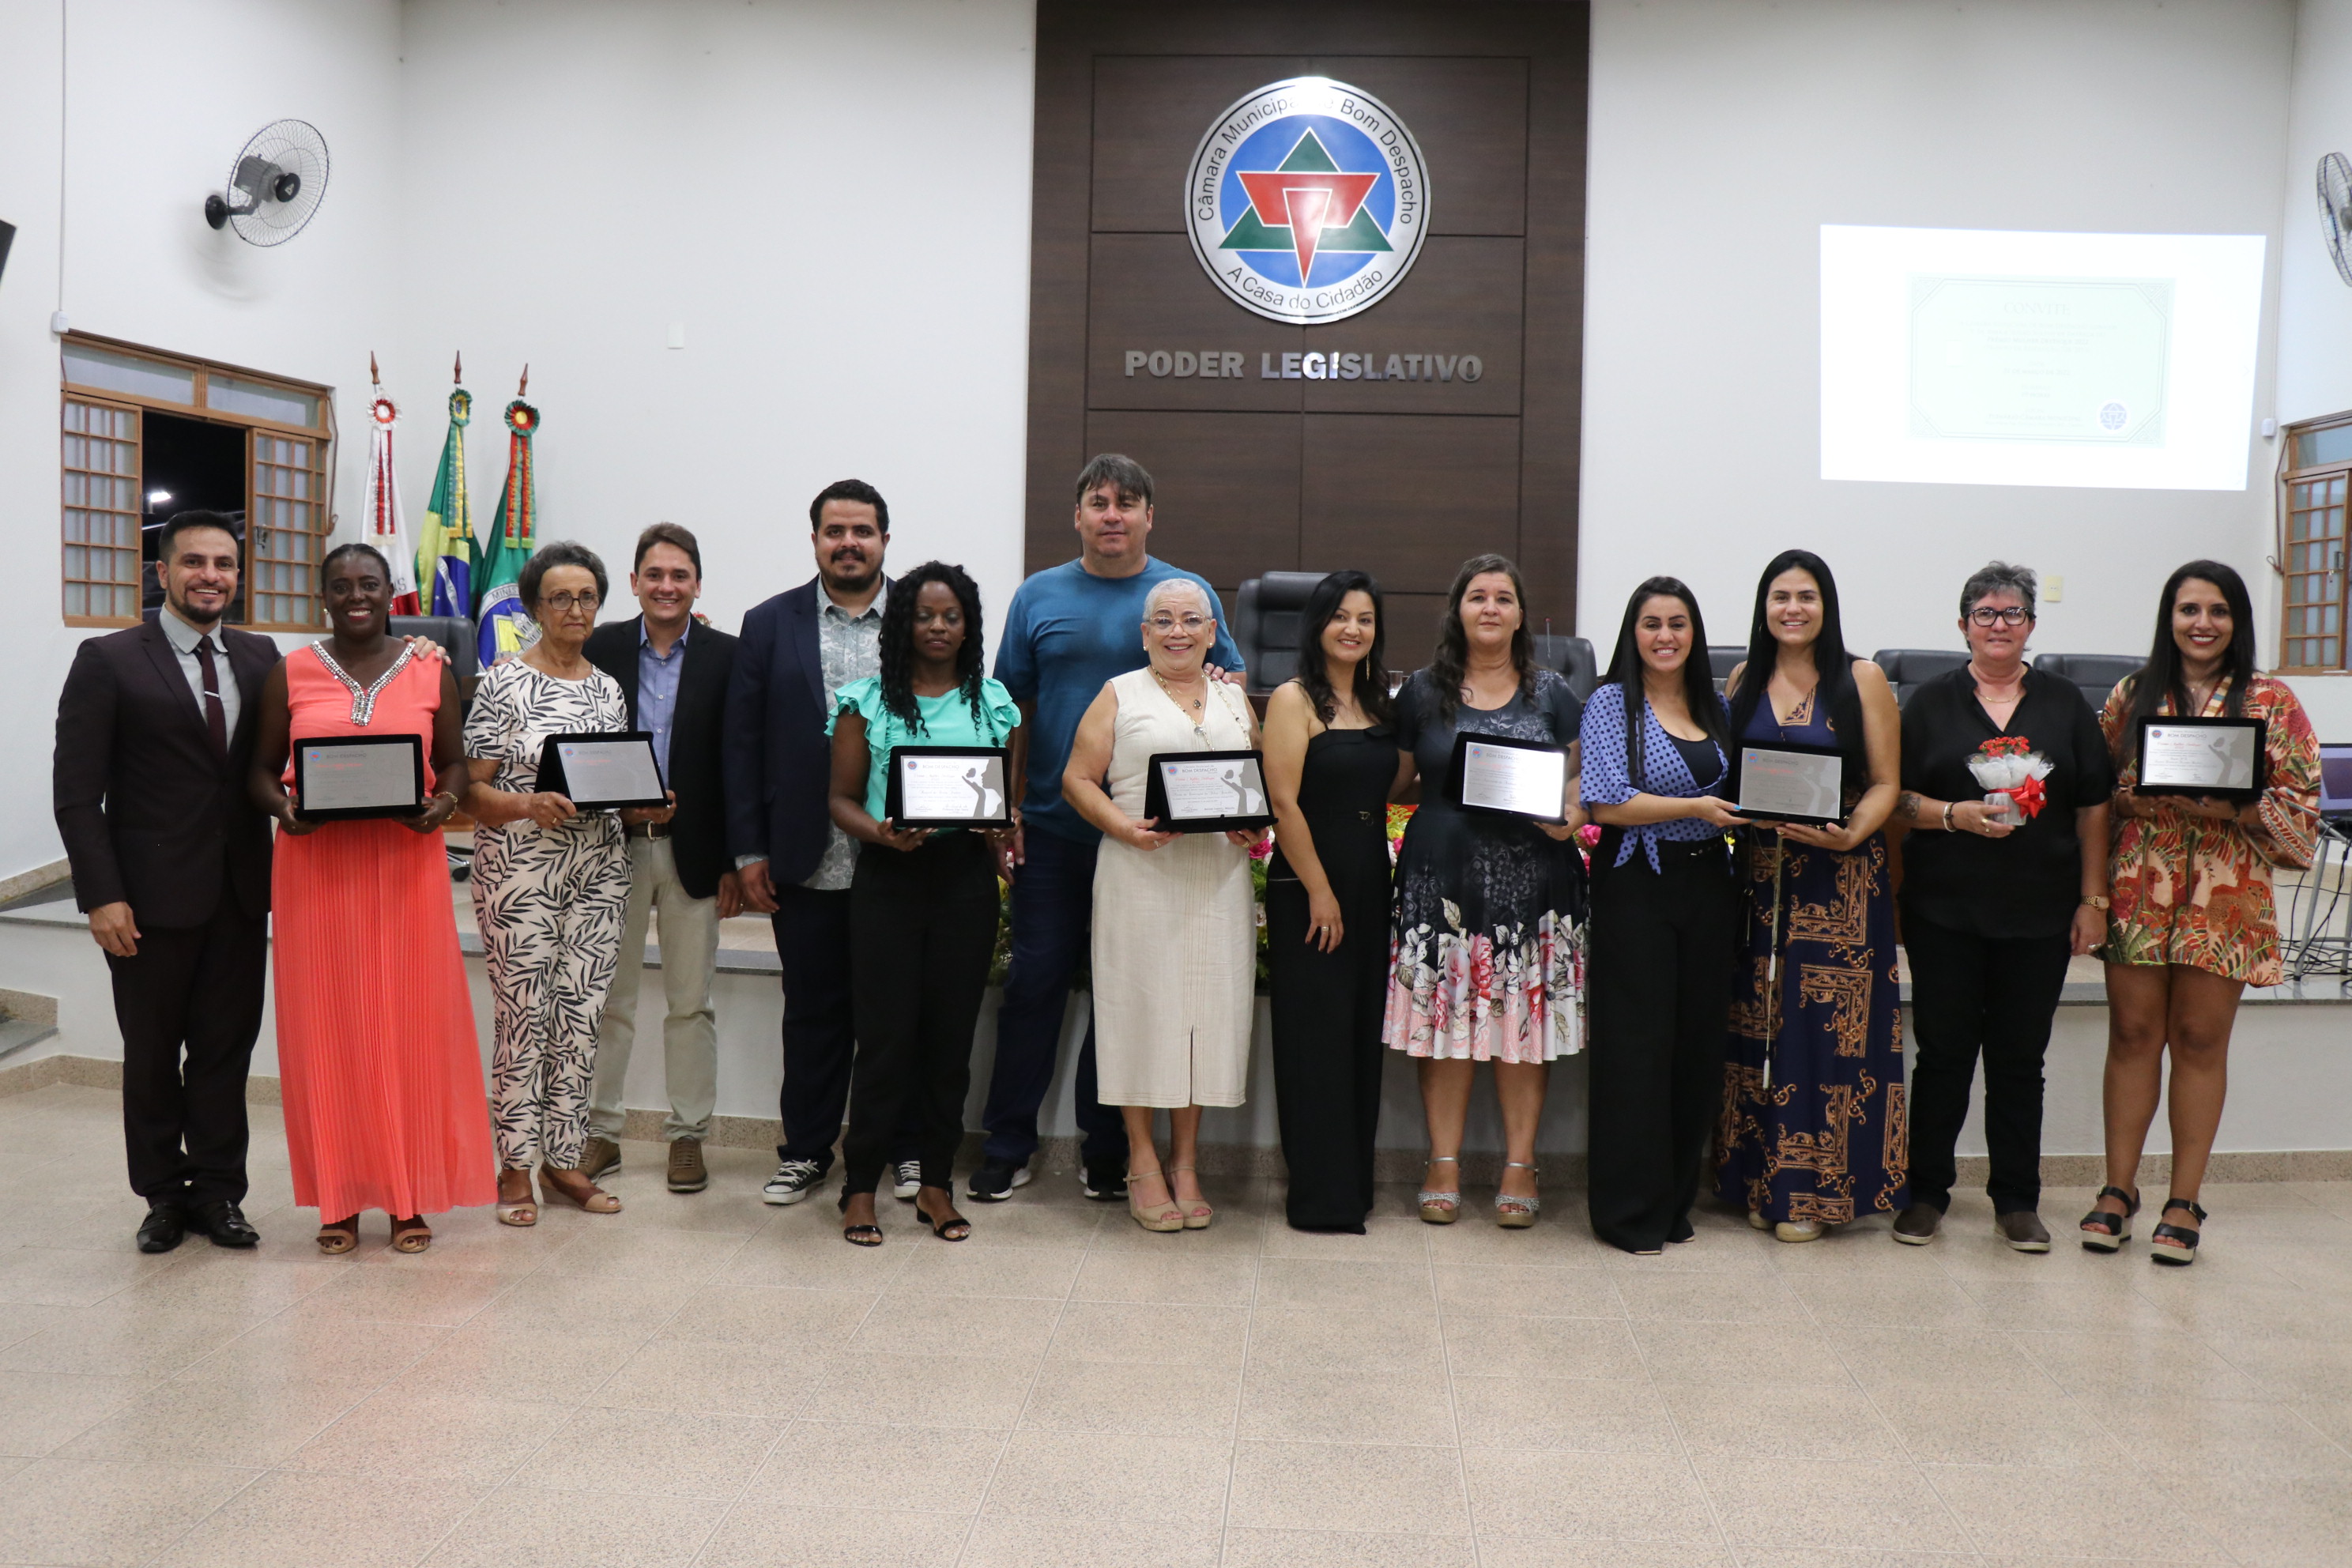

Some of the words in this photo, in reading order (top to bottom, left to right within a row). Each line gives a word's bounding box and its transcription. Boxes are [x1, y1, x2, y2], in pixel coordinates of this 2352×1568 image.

[1198, 147, 1227, 220] Câmara
[1222, 96, 1303, 145] Municipa
[1340, 98, 1381, 132] Bom
[1379, 129, 1417, 224] Despacho
[1227, 266, 1245, 284] A
[1242, 277, 1284, 307] Casa
[1289, 293, 1311, 310] do
[1316, 270, 1383, 309] Cidadão
[2003, 301, 2071, 316] CONVITE
[1125, 350, 1246, 379] PODER
[1261, 352, 1483, 383] LEGISLATIVO
